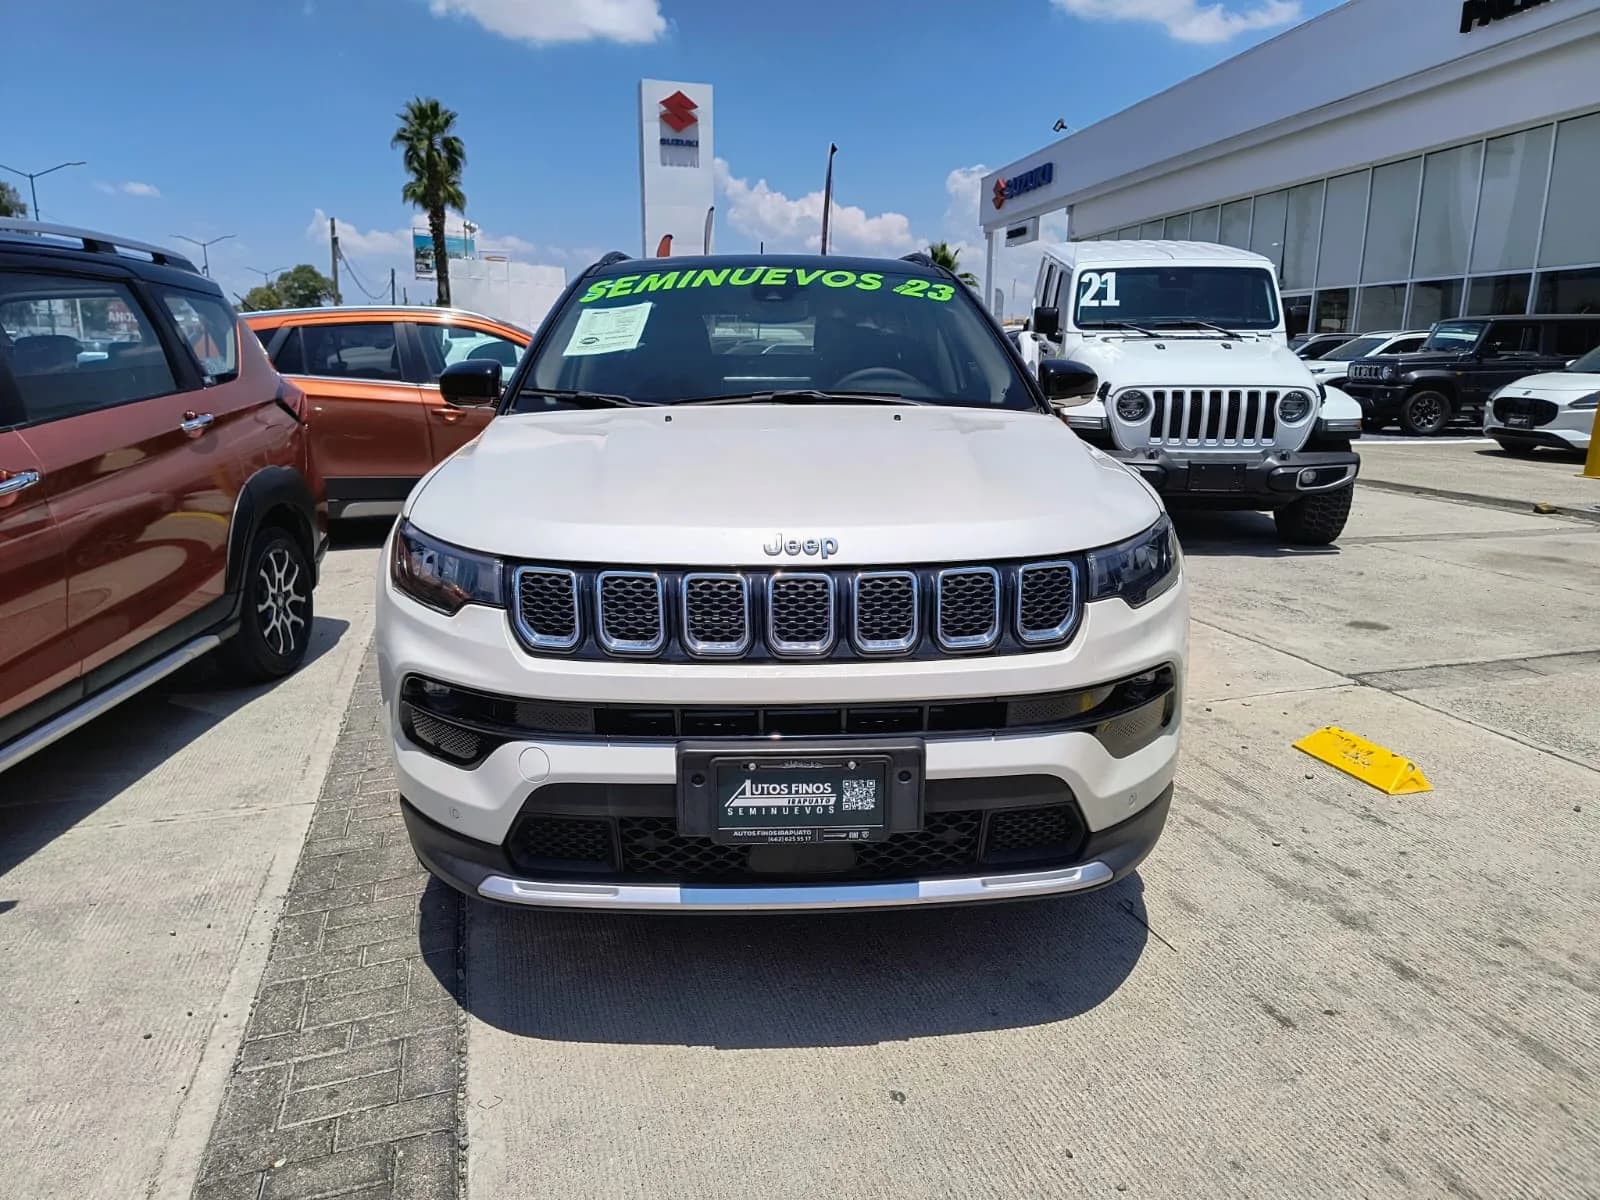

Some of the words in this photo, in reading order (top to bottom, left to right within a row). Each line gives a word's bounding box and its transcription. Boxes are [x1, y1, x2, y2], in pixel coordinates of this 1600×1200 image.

[579, 267, 884, 303] SEMINUEVOS
[1079, 271, 1120, 307] 21
[763, 532, 839, 560] Jeep
[724, 779, 789, 807] AUTOS
[791, 782, 832, 795] FINOS
[787, 797, 831, 805] IRAPUATO
[727, 806, 835, 816] SEMINUEVOS
